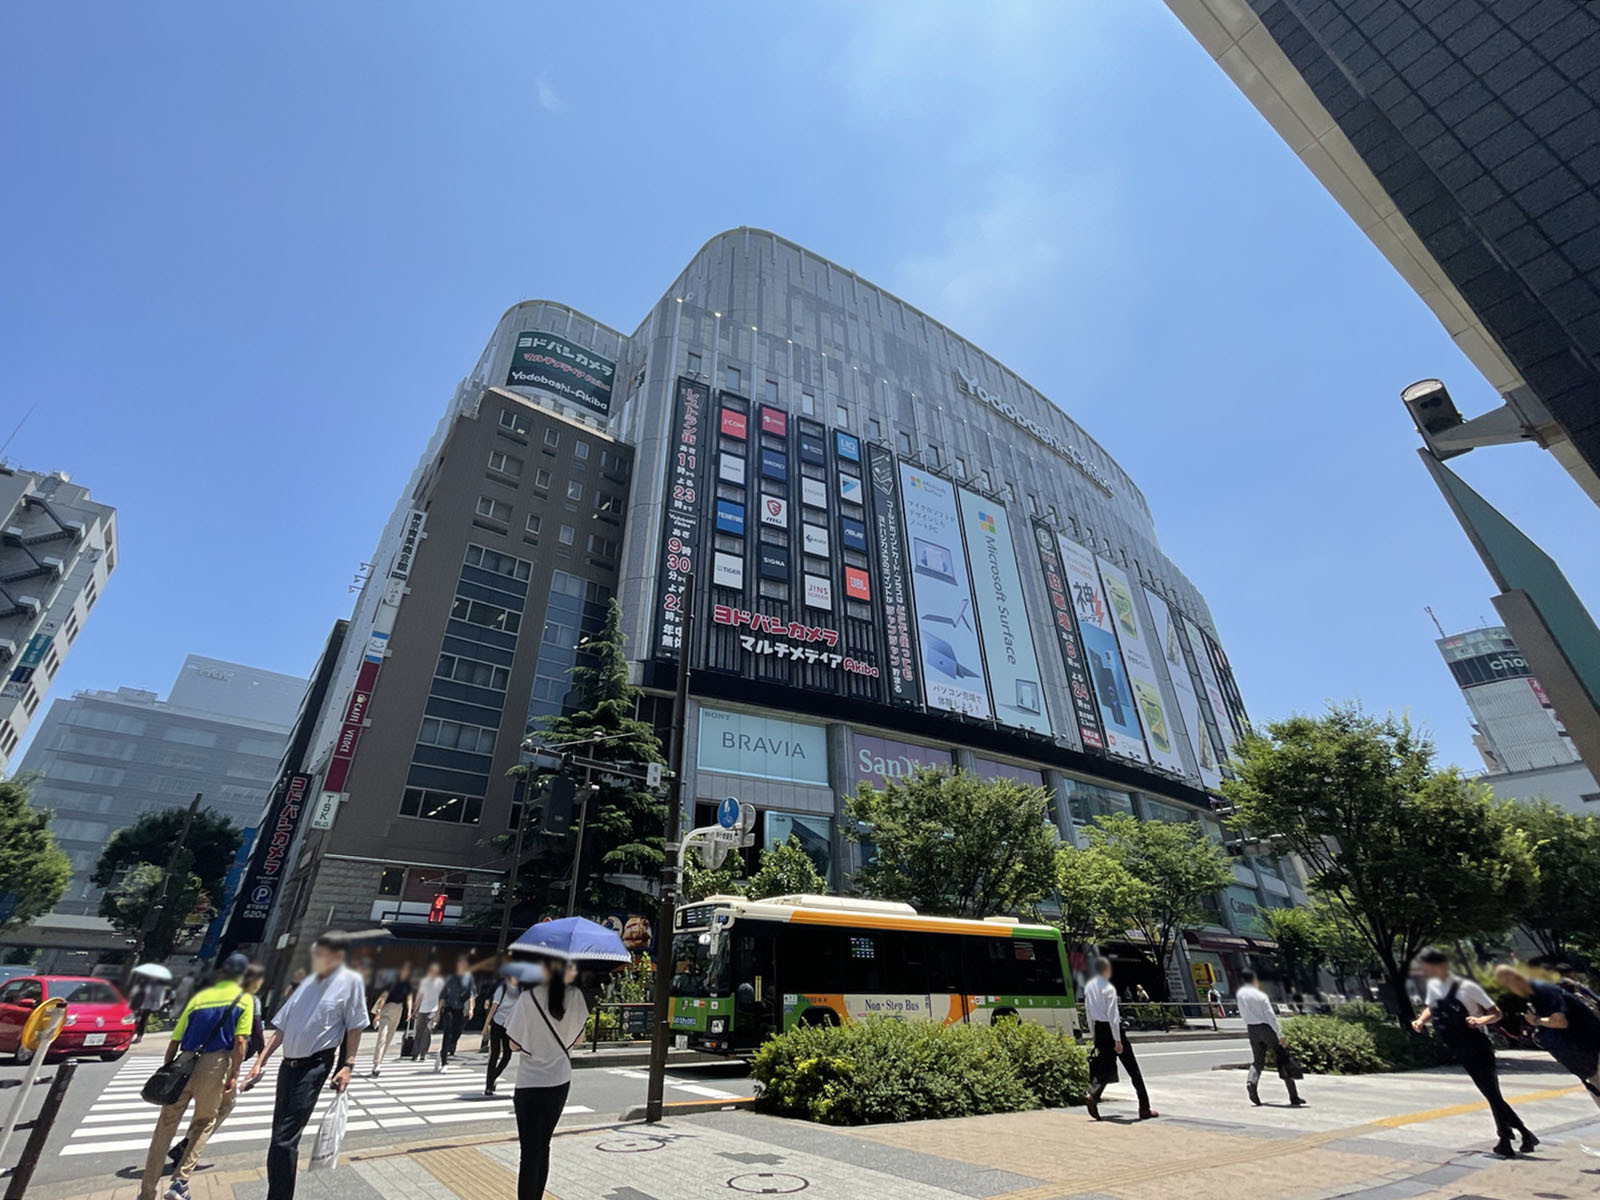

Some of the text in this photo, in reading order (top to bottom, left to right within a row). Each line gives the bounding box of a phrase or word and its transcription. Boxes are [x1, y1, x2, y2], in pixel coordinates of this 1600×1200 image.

[518, 337, 613, 377] ヨドバシカメラ
[511, 370, 607, 410] Yodobashi-Akiba
[677, 452, 696, 470] 11
[672, 484, 696, 503] 23
[666, 553, 692, 573] 30
[763, 557, 786, 568] SIGMA
[808, 584, 828, 596] JINS
[984, 535, 1017, 665] Microsoft Surface
[1073, 581, 1096, 614] 神
[713, 604, 839, 647] ヨドバシカメラ
[740, 635, 879, 678] マルチメディア Akiba
[1490, 654, 1529, 671] cho
[1072, 681, 1089, 701] 24
[704, 711, 731, 721] SONY
[722, 731, 806, 759] BRAVIA
[319, 794, 335, 820] TSK
[263, 776, 308, 876] ヨドバシカメラ
[905, 999, 920, 1011] Bus
